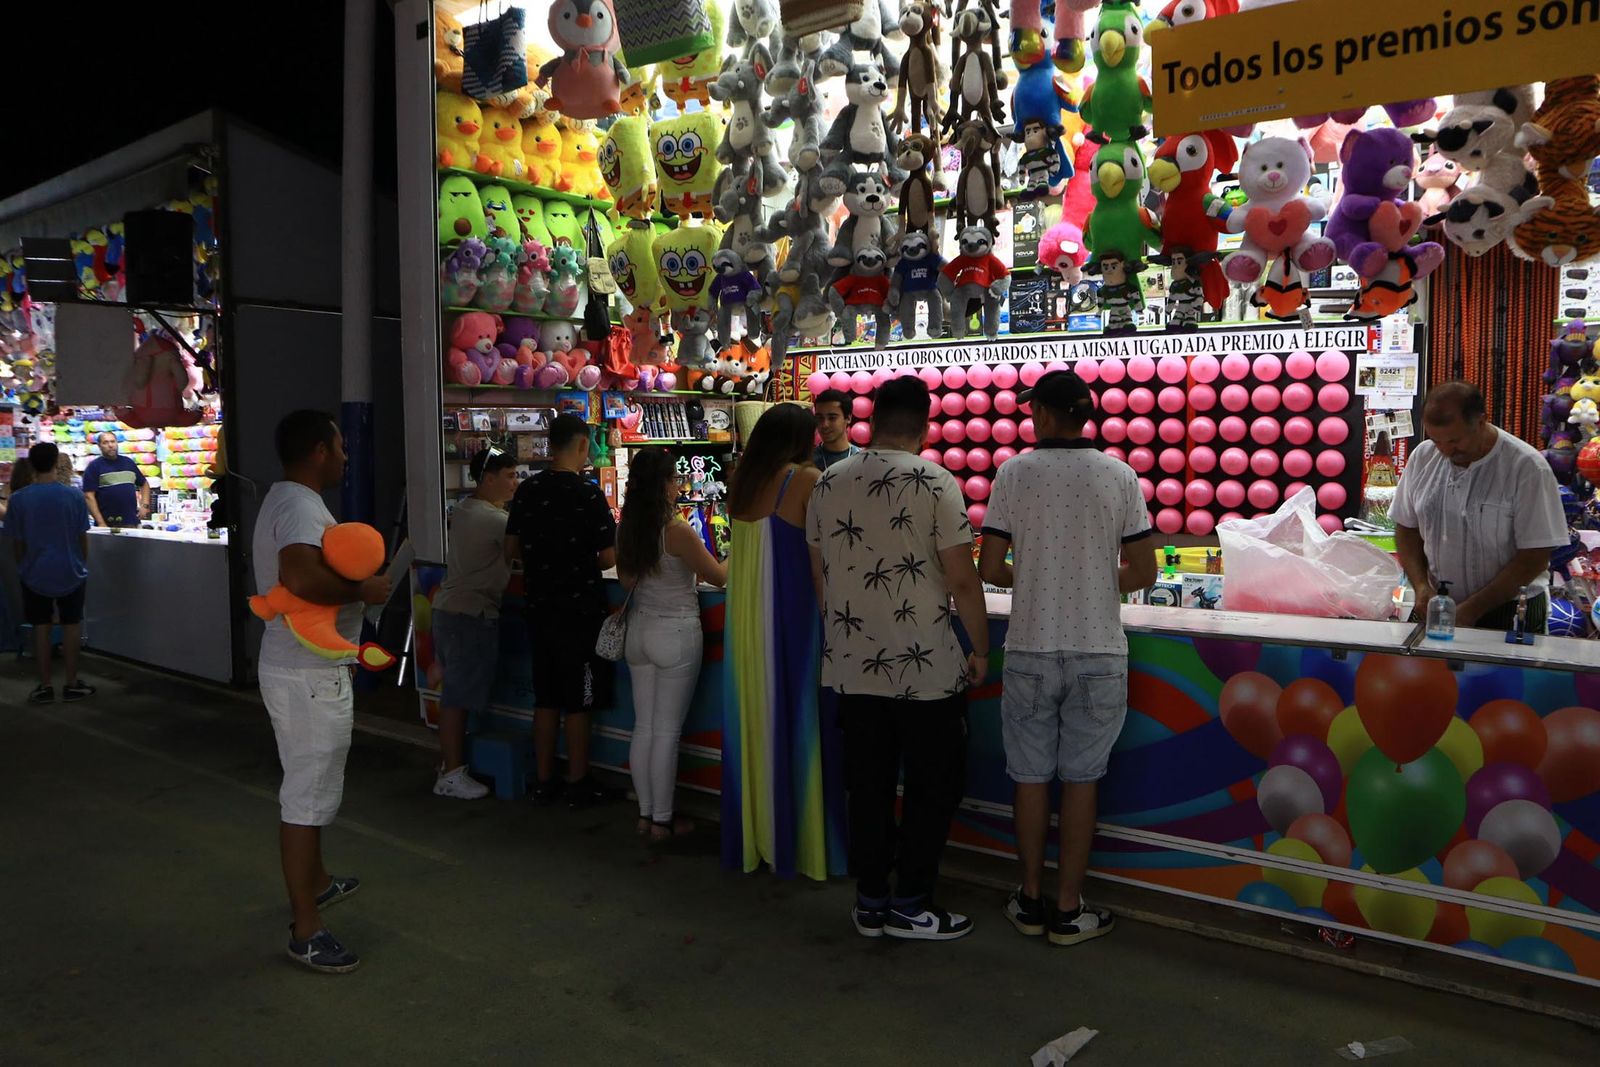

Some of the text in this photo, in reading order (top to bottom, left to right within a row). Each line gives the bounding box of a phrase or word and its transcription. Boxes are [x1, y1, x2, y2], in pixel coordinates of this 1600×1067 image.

[1162, 0, 1600, 95] Todos los premios son
[818, 354, 884, 371] PINCHANDO
[887, 353, 893, 367] 3
[896, 349, 943, 367] GLOBOS
[945, 347, 971, 364] CON
[983, 344, 1037, 362] DARDOS
[1041, 343, 1058, 359] EN
[1062, 343, 1078, 358] LA
[1082, 340, 1130, 357] MISMA
[1221, 333, 1284, 352] PREMIO
[1288, 332, 1300, 350] A
[1304, 329, 1365, 349] ELEGIR
